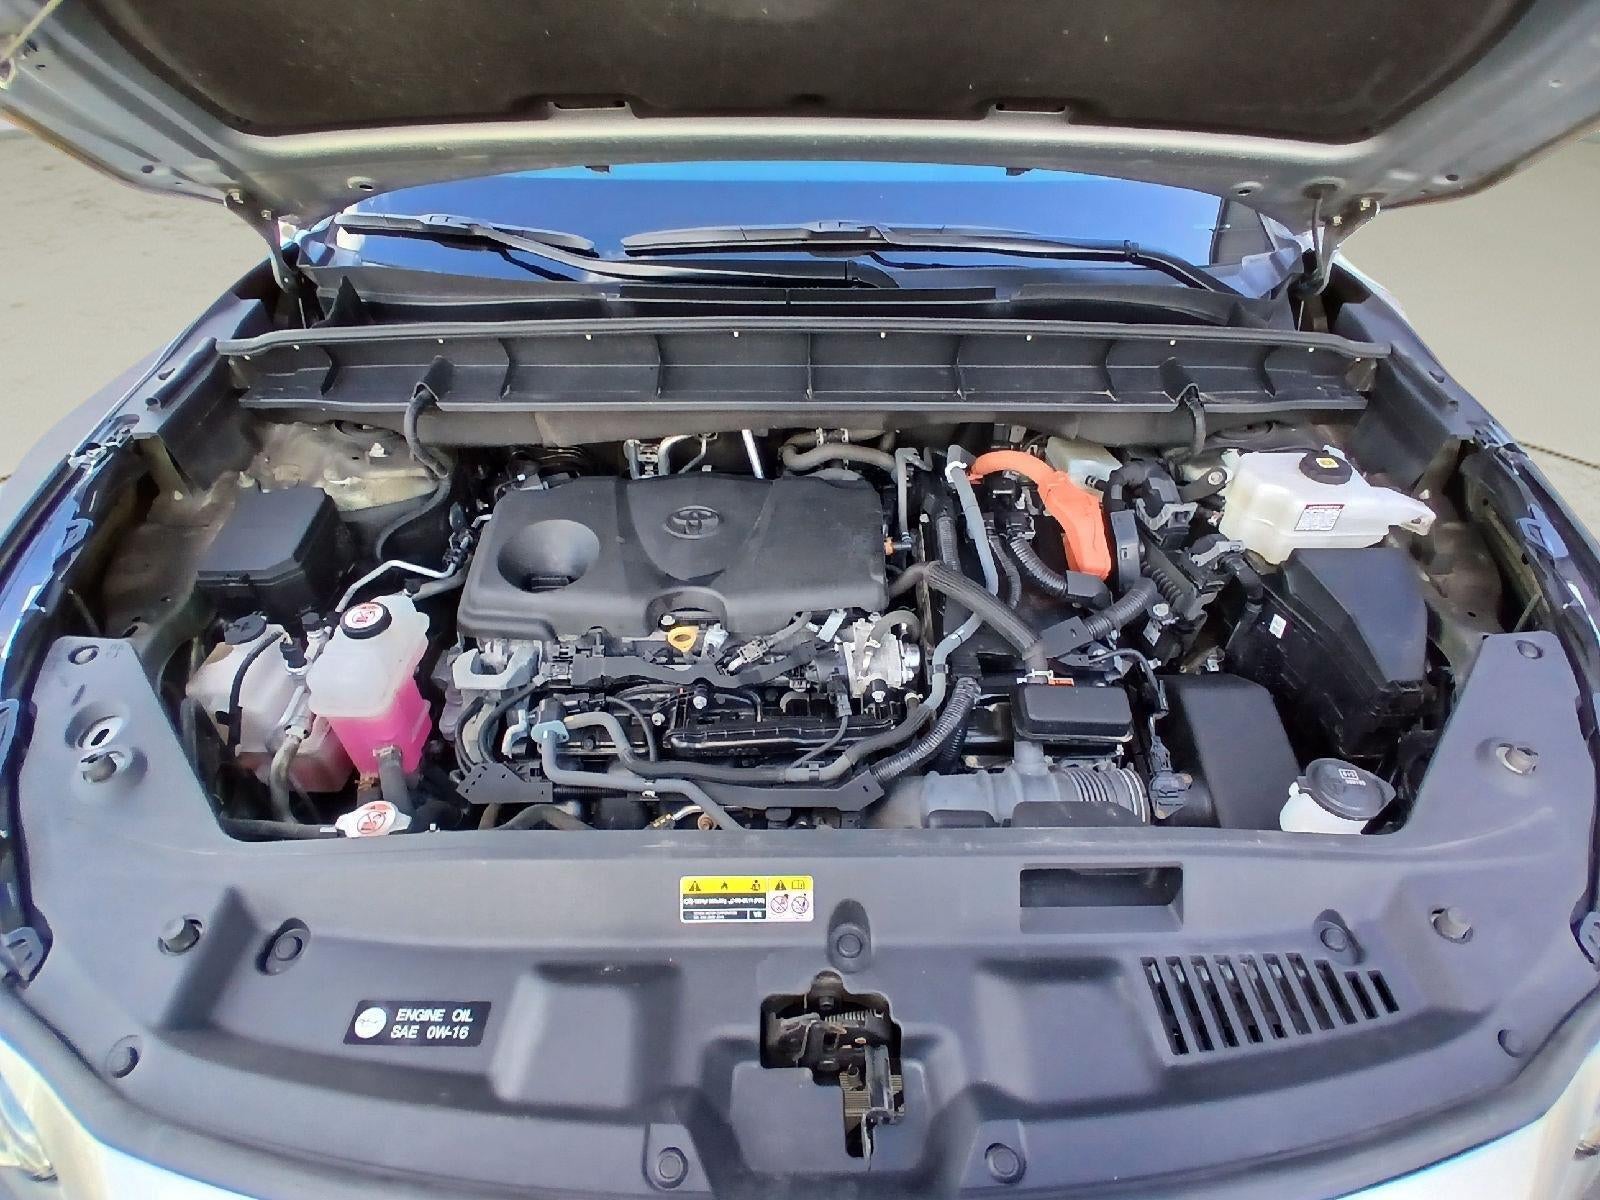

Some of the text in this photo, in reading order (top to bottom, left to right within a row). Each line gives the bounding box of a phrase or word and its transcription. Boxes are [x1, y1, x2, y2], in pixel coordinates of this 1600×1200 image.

[395, 1008, 474, 1022] ENGINE OIL
[390, 1024, 470, 1040] SAE 0W-16
